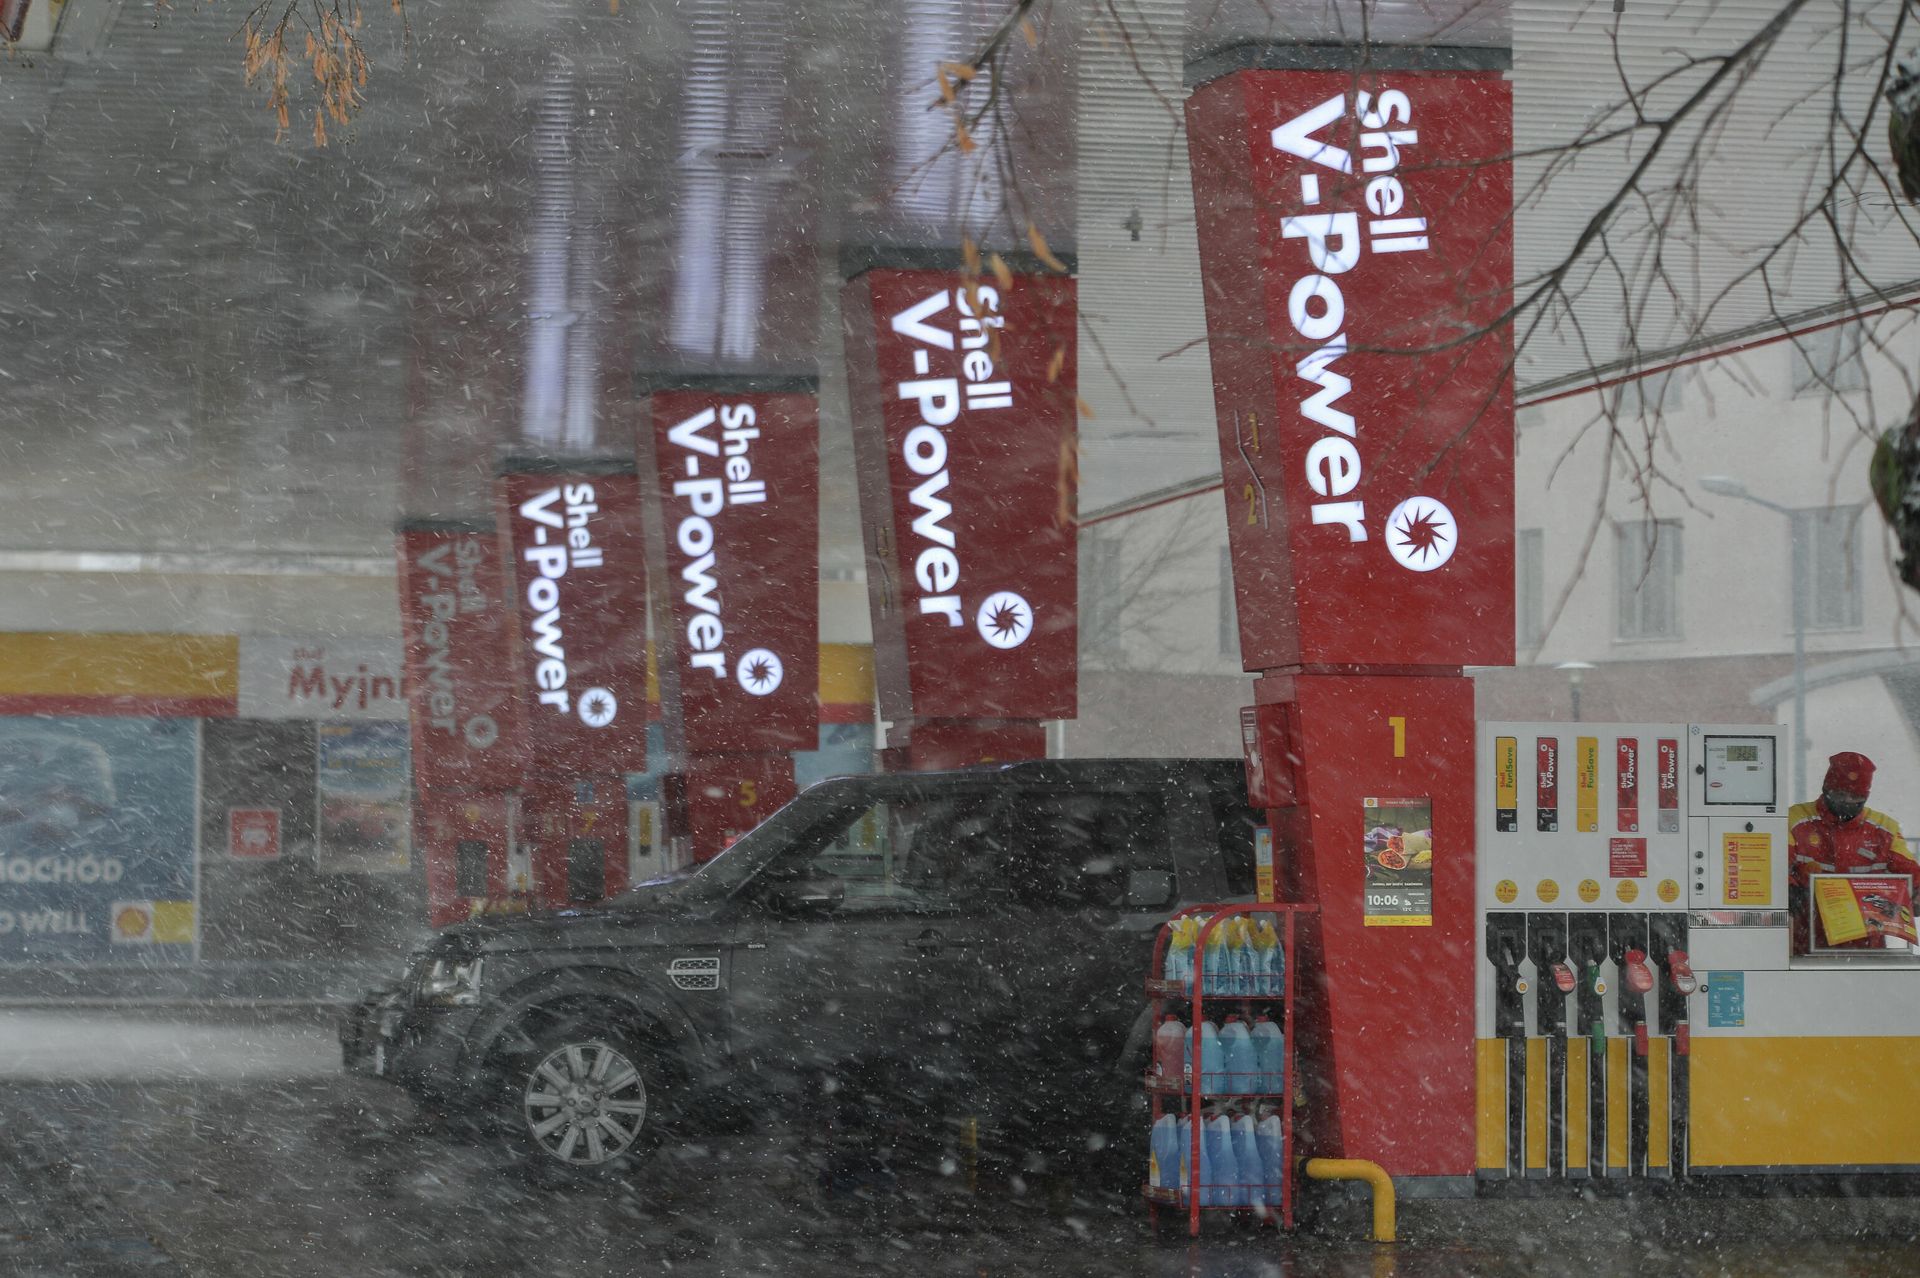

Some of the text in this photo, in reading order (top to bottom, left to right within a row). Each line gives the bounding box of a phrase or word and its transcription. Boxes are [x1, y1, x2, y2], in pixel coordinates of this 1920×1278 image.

[1355, 88, 1430, 254] Shell
[956, 285, 1013, 410] Shell
[1270, 93, 1368, 543] V-Power
[720, 403, 767, 505] Shell
[891, 289, 964, 627] V-Power
[563, 482, 604, 568] Shell
[1244, 483, 1258, 525] 2
[455, 539, 488, 614] Shell
[667, 406, 728, 679] V-Power
[519, 486, 571, 714] V-Power
[417, 544, 457, 737] V-Power
[1388, 716, 1406, 758] 1
[1505, 746, 1513, 788] FuelSave
[1546, 747, 1555, 788] V-Power
[1587, 747, 1595, 788] FuelSave
[1626, 747, 1635, 788] V-Power
[1667, 747, 1675, 789] V-Power
[739, 780, 757, 806] 5
[1367, 895, 1399, 906] 10:06
